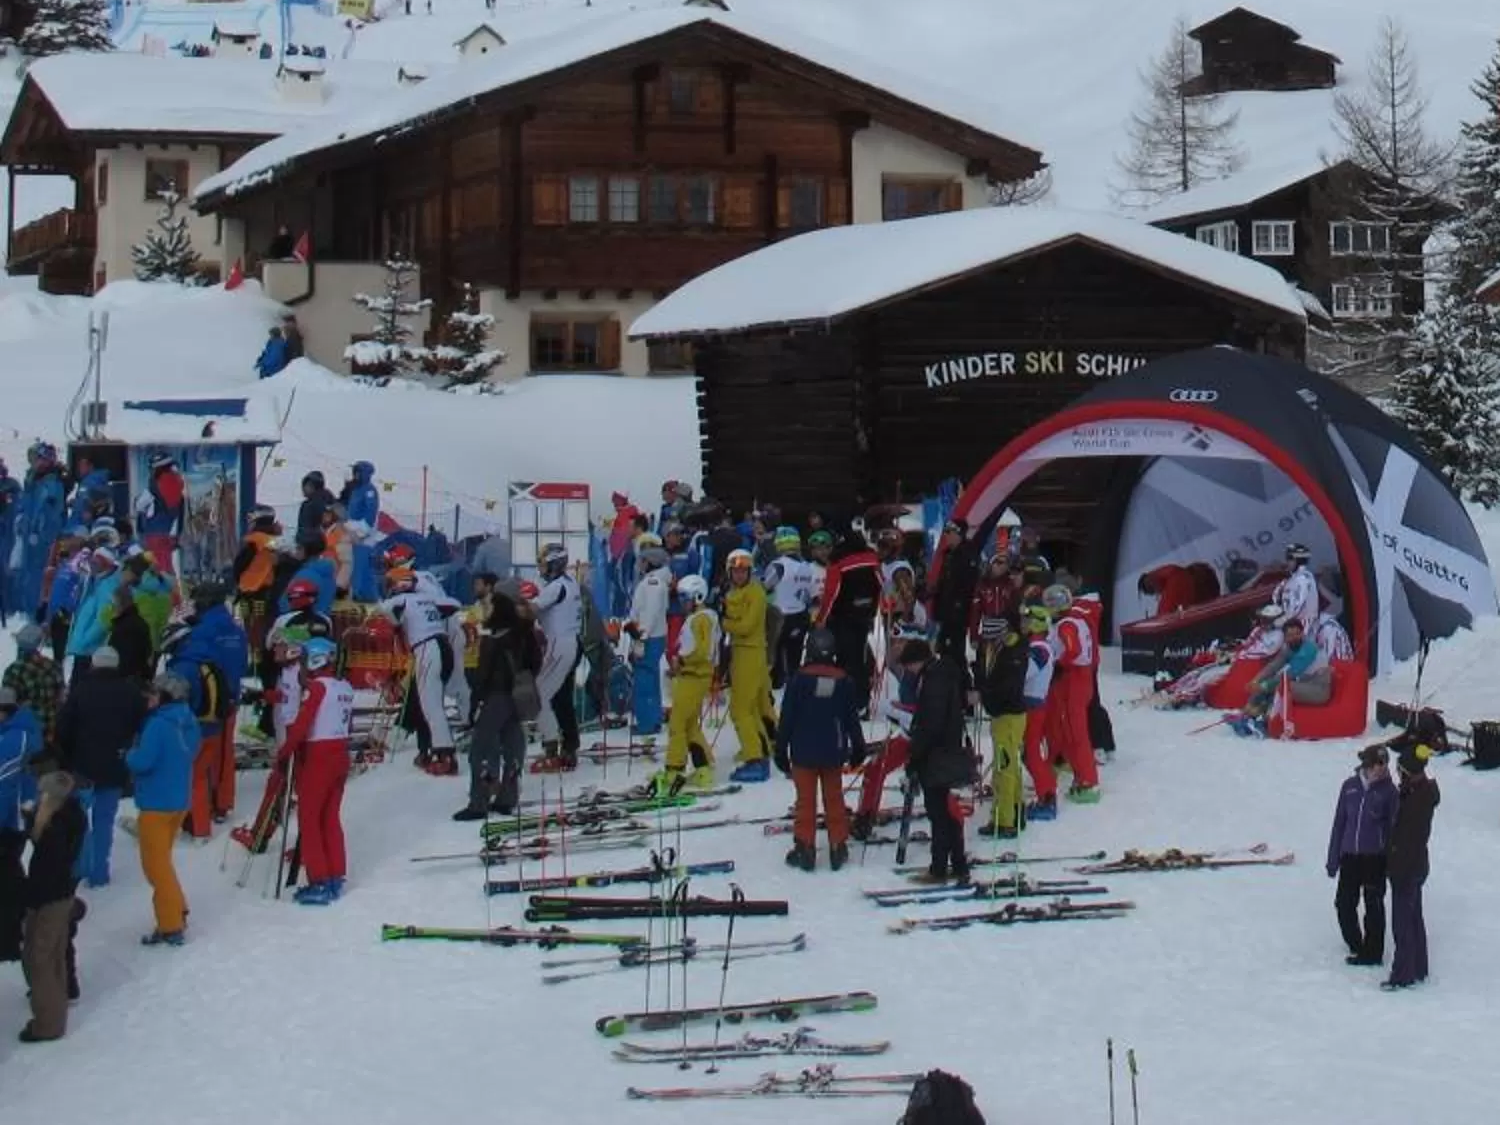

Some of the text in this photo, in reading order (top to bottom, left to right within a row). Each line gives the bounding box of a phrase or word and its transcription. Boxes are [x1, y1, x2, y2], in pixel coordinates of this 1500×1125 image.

[924, 351, 1147, 388] KINDER SKI SCHU
